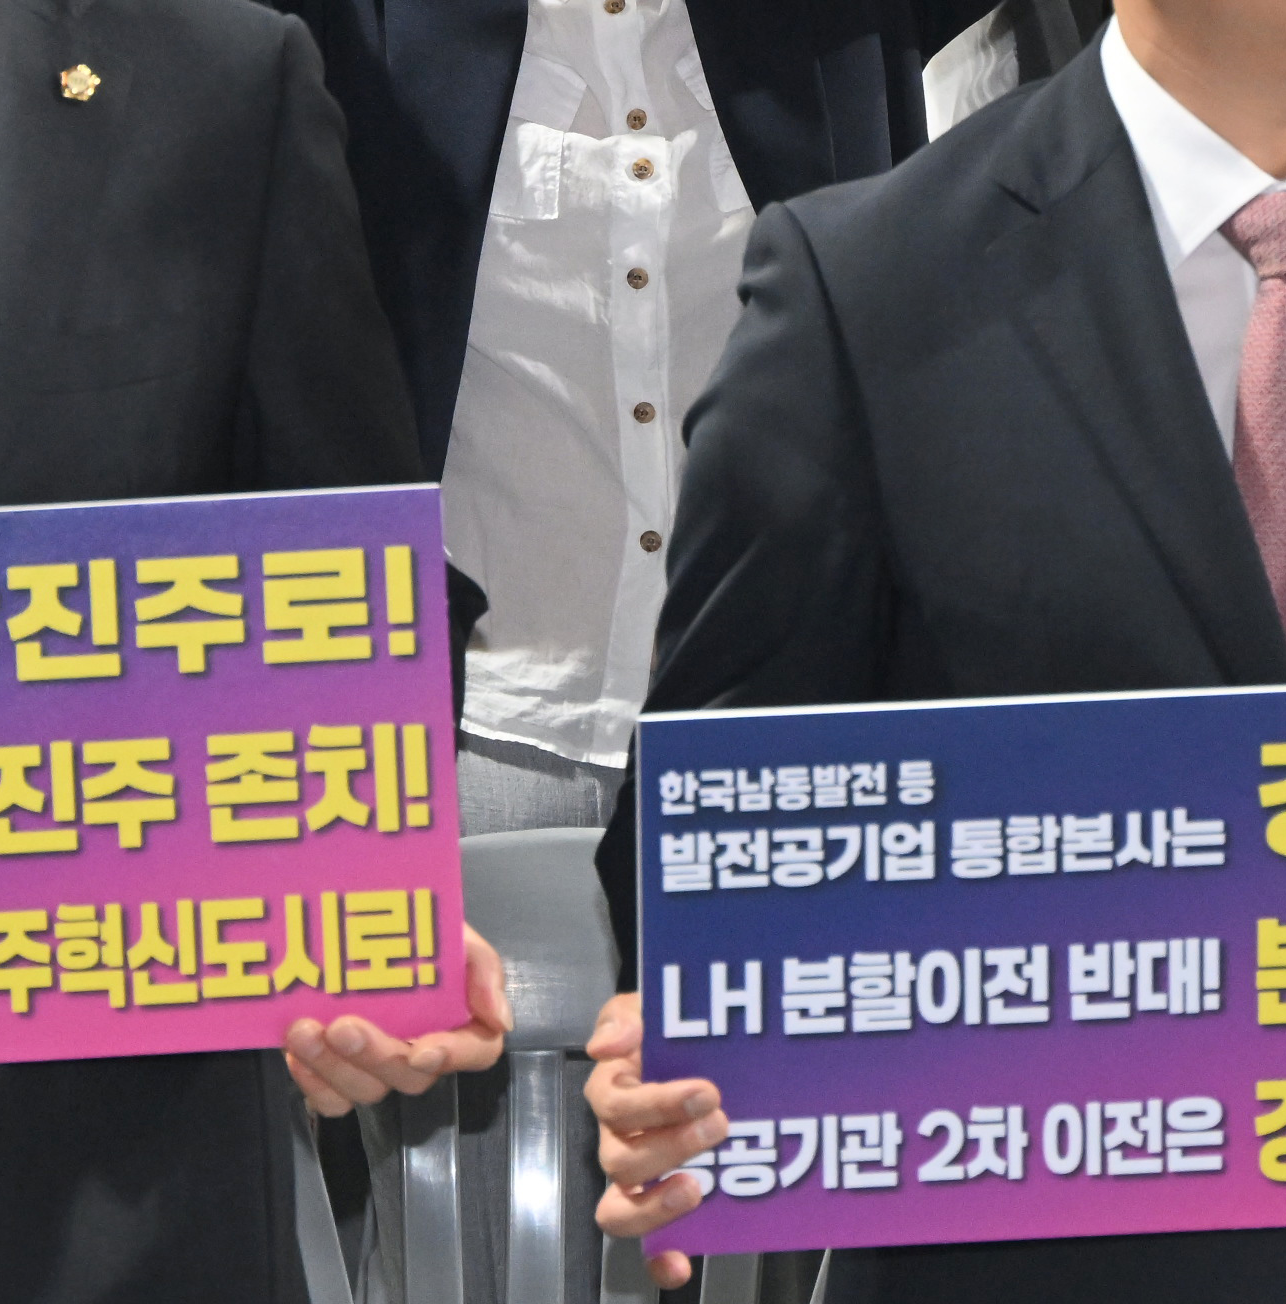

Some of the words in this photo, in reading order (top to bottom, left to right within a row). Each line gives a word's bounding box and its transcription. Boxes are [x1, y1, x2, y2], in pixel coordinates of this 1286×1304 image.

[205, 722, 430, 844] 존치!
[659, 763, 887, 815] 한국남동발전
[897, 760, 936, 806] 등
[660, 822, 936, 892] 발전공기업
[949, 808, 1226, 880] 통합본사는
[662, 960, 763, 1039] LH
[782, 945, 1050, 1035] 분할이전
[1068, 938, 1221, 1021] 반대!
[917, 1106, 1029, 1184] 2차
[1043, 1096, 1225, 1177] 이전은
